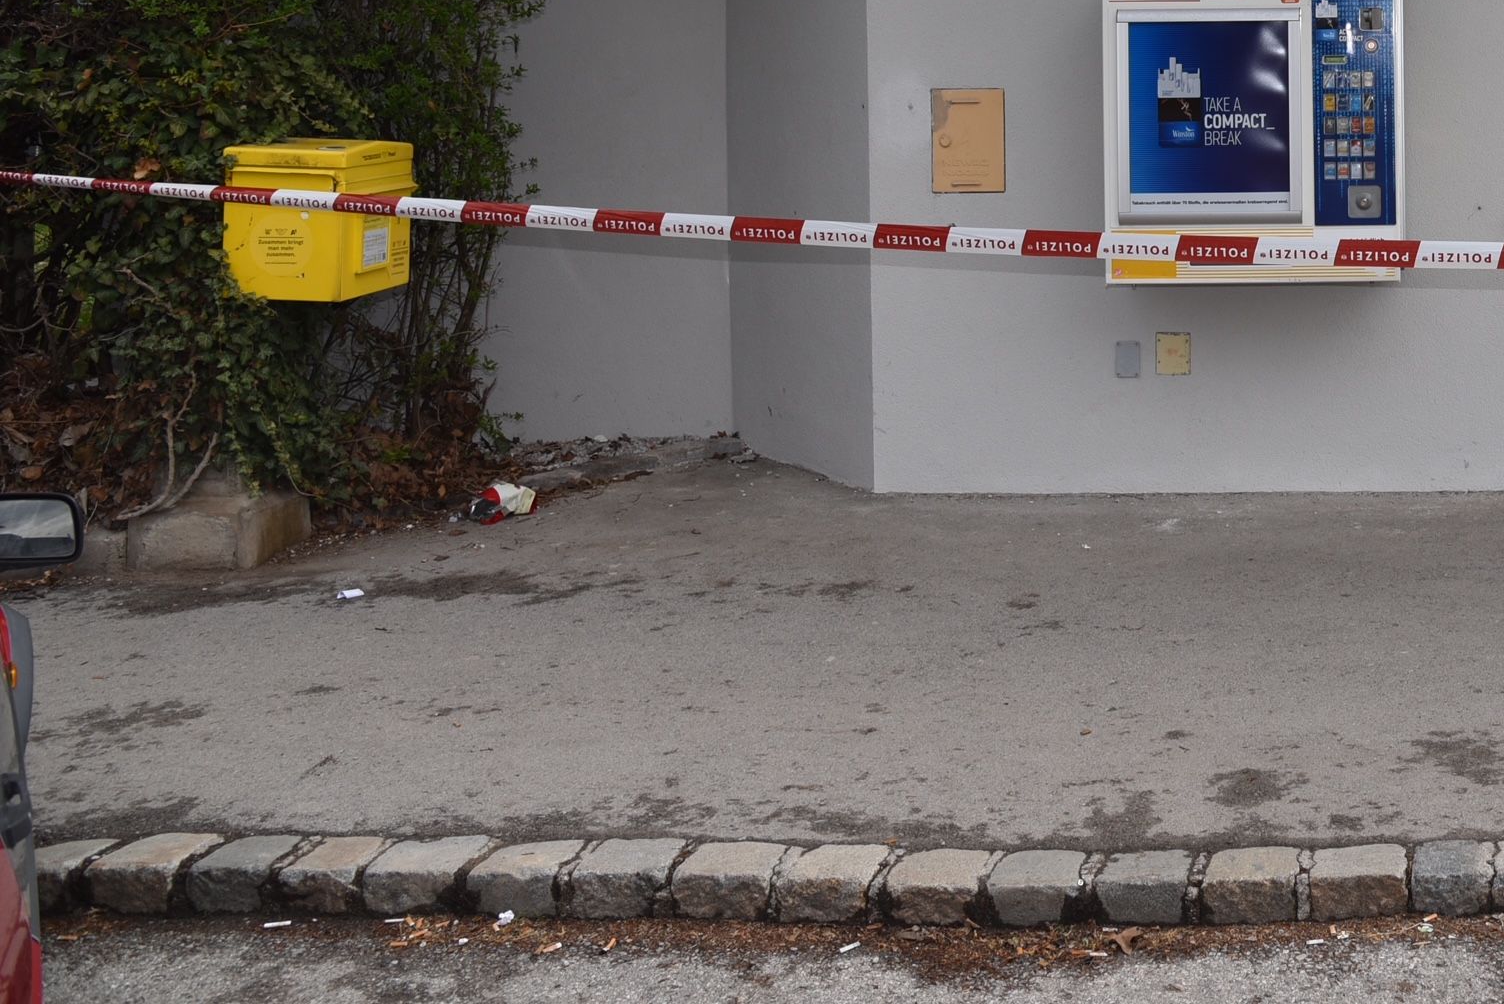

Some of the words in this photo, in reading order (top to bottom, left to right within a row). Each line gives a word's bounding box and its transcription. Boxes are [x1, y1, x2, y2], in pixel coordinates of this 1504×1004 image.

[1203, 97, 1231, 112] TAKE
[1233, 97, 1242, 112] A
[1172, 129, 1195, 138] Winston
[1204, 131, 1242, 146] BREAK
[221, 191, 266, 205] POLIZEI
[282, 196, 328, 209] POLIZEI
[344, 201, 391, 214] POLIZEI
[407, 206, 455, 219] POLIZEI
[472, 210, 521, 223] POLIZEI
[537, 216, 588, 228] POLIZEI
[605, 220, 655, 232] POLIZEI
[673, 224, 724, 236] POLIZEI
[743, 228, 795, 240] POLIZEI
[814, 231, 867, 243] POLIZEI
[886, 235, 941, 247] POLIZEI
[960, 238, 1016, 250] POLIZEI
[1036, 241, 1092, 253] POLIZEI
[1112, 244, 1169, 256] POLIZEI
[1190, 246, 1248, 259] POLIZEI
[1269, 248, 1328, 260] POLIZEI
[1350, 250, 1409, 262] POLIZEI
[1431, 252, 1492, 264] POLIZEI
